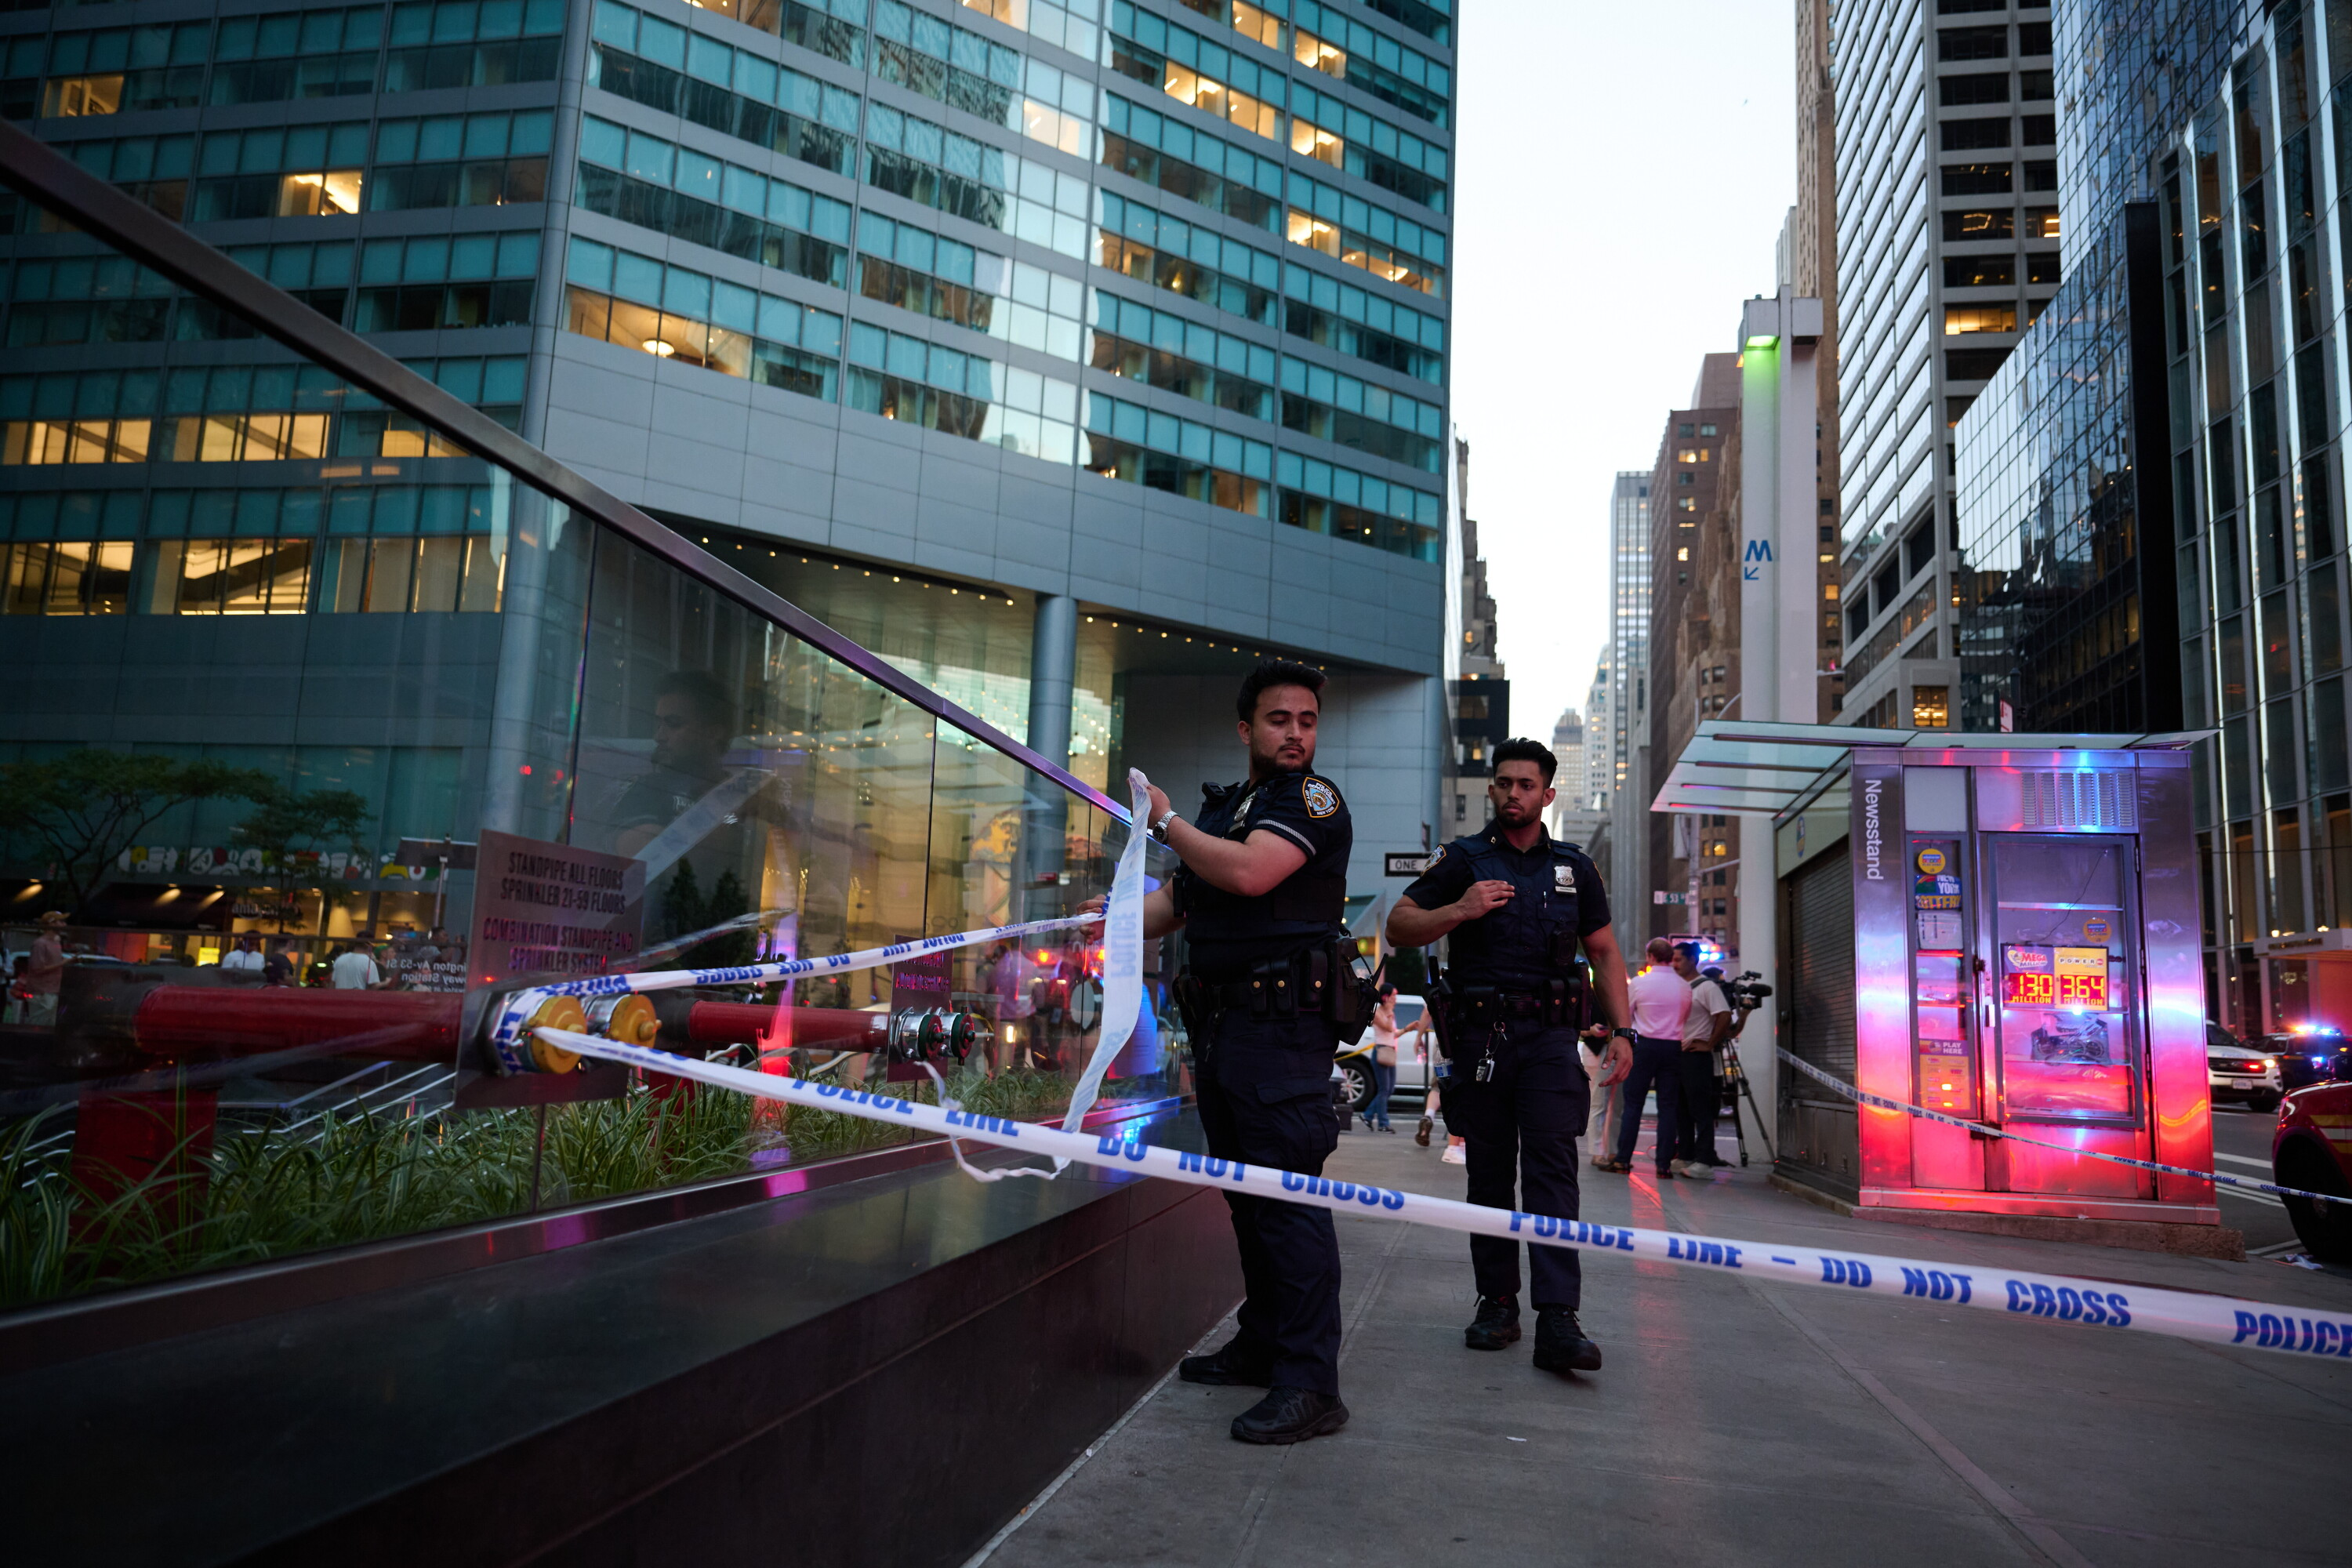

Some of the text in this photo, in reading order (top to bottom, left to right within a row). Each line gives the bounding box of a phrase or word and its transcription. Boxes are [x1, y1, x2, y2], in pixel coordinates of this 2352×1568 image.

[1744, 539, 1773, 561] M
[1316, 782, 1333, 796] POLICE
[1864, 779, 1884, 880] Newsstand
[509, 851, 624, 891] STANDPIPE ALL FLOORS
[1395, 859, 1417, 870] ONE
[500, 877, 626, 915] SPRINKLER 21-59 FLOORS
[1669, 892, 1679, 904] 53
[1938, 882, 1961, 895] YORK
[483, 917, 633, 953] COMBINATION STANDPIPE AND
[509, 947, 608, 975] SPRINKLER SYSTEM
[2020, 953, 2047, 962] MEGA
[2020, 974, 2053, 997] 130
[2062, 975, 2104, 998] 364
[792, 1079, 913, 1115] POLICE
[1097, 1136, 1148, 1162] DO
[1178, 1152, 1247, 1183] NOT
[1282, 1171, 1404, 1210] CROSS
[1509, 1210, 1635, 1251] POLICE
[1667, 1236, 1742, 1269] LINE
[1819, 1256, 1872, 1287] DO
[1900, 1266, 1974, 1305] NOT
[2005, 1279, 2132, 1327] CROSS
